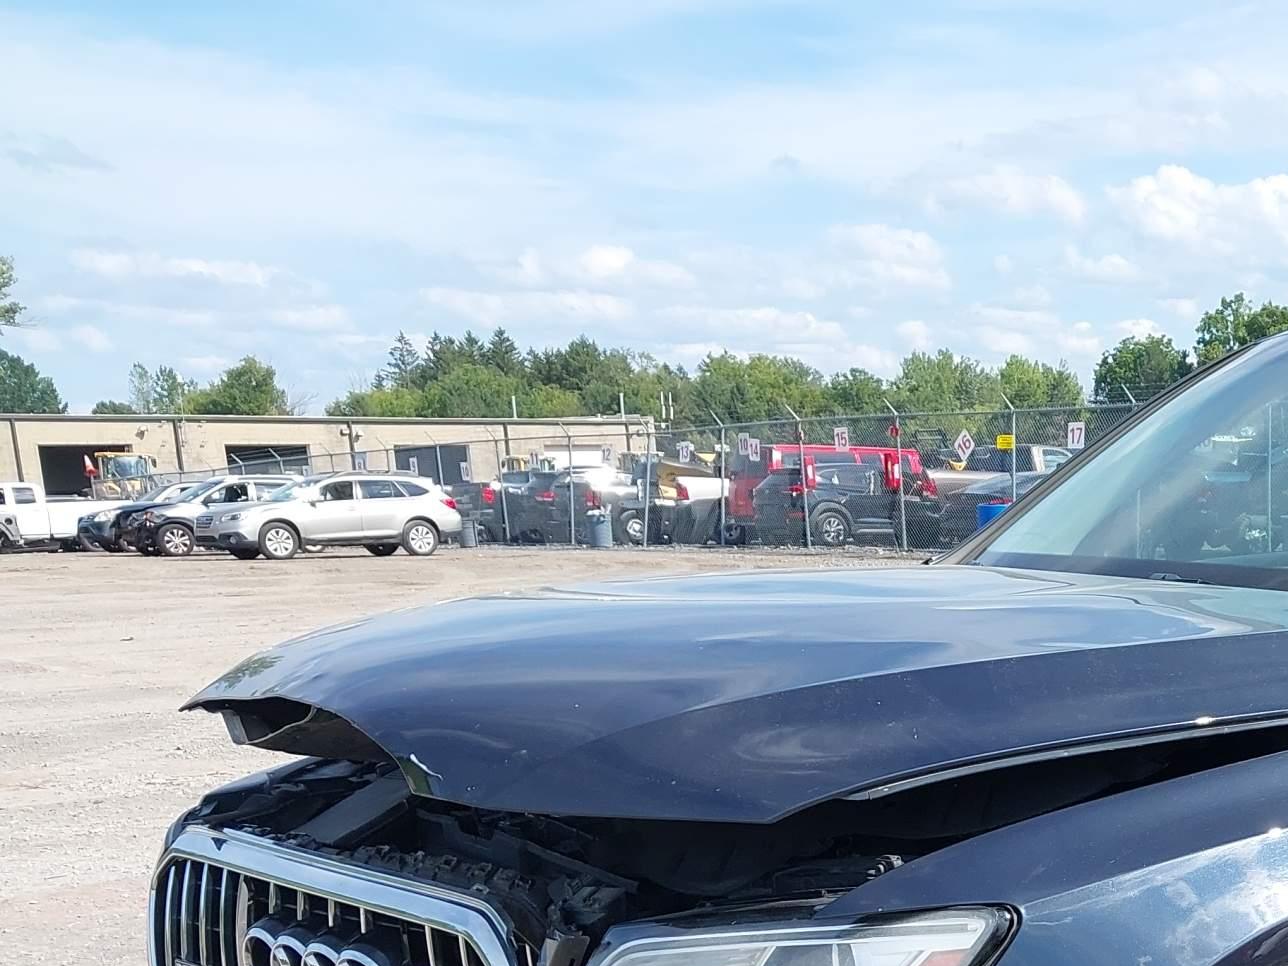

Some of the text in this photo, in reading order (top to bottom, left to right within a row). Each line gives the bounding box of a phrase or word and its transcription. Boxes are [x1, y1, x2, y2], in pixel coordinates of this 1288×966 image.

[836, 431, 847, 447] 15
[1069, 427, 1083, 444] 17
[681, 446, 689, 458] 13
[740, 439, 748, 455] 10
[750, 443, 758, 457] 14
[957, 434, 971, 455] 16
[601, 448, 611, 462] 12
